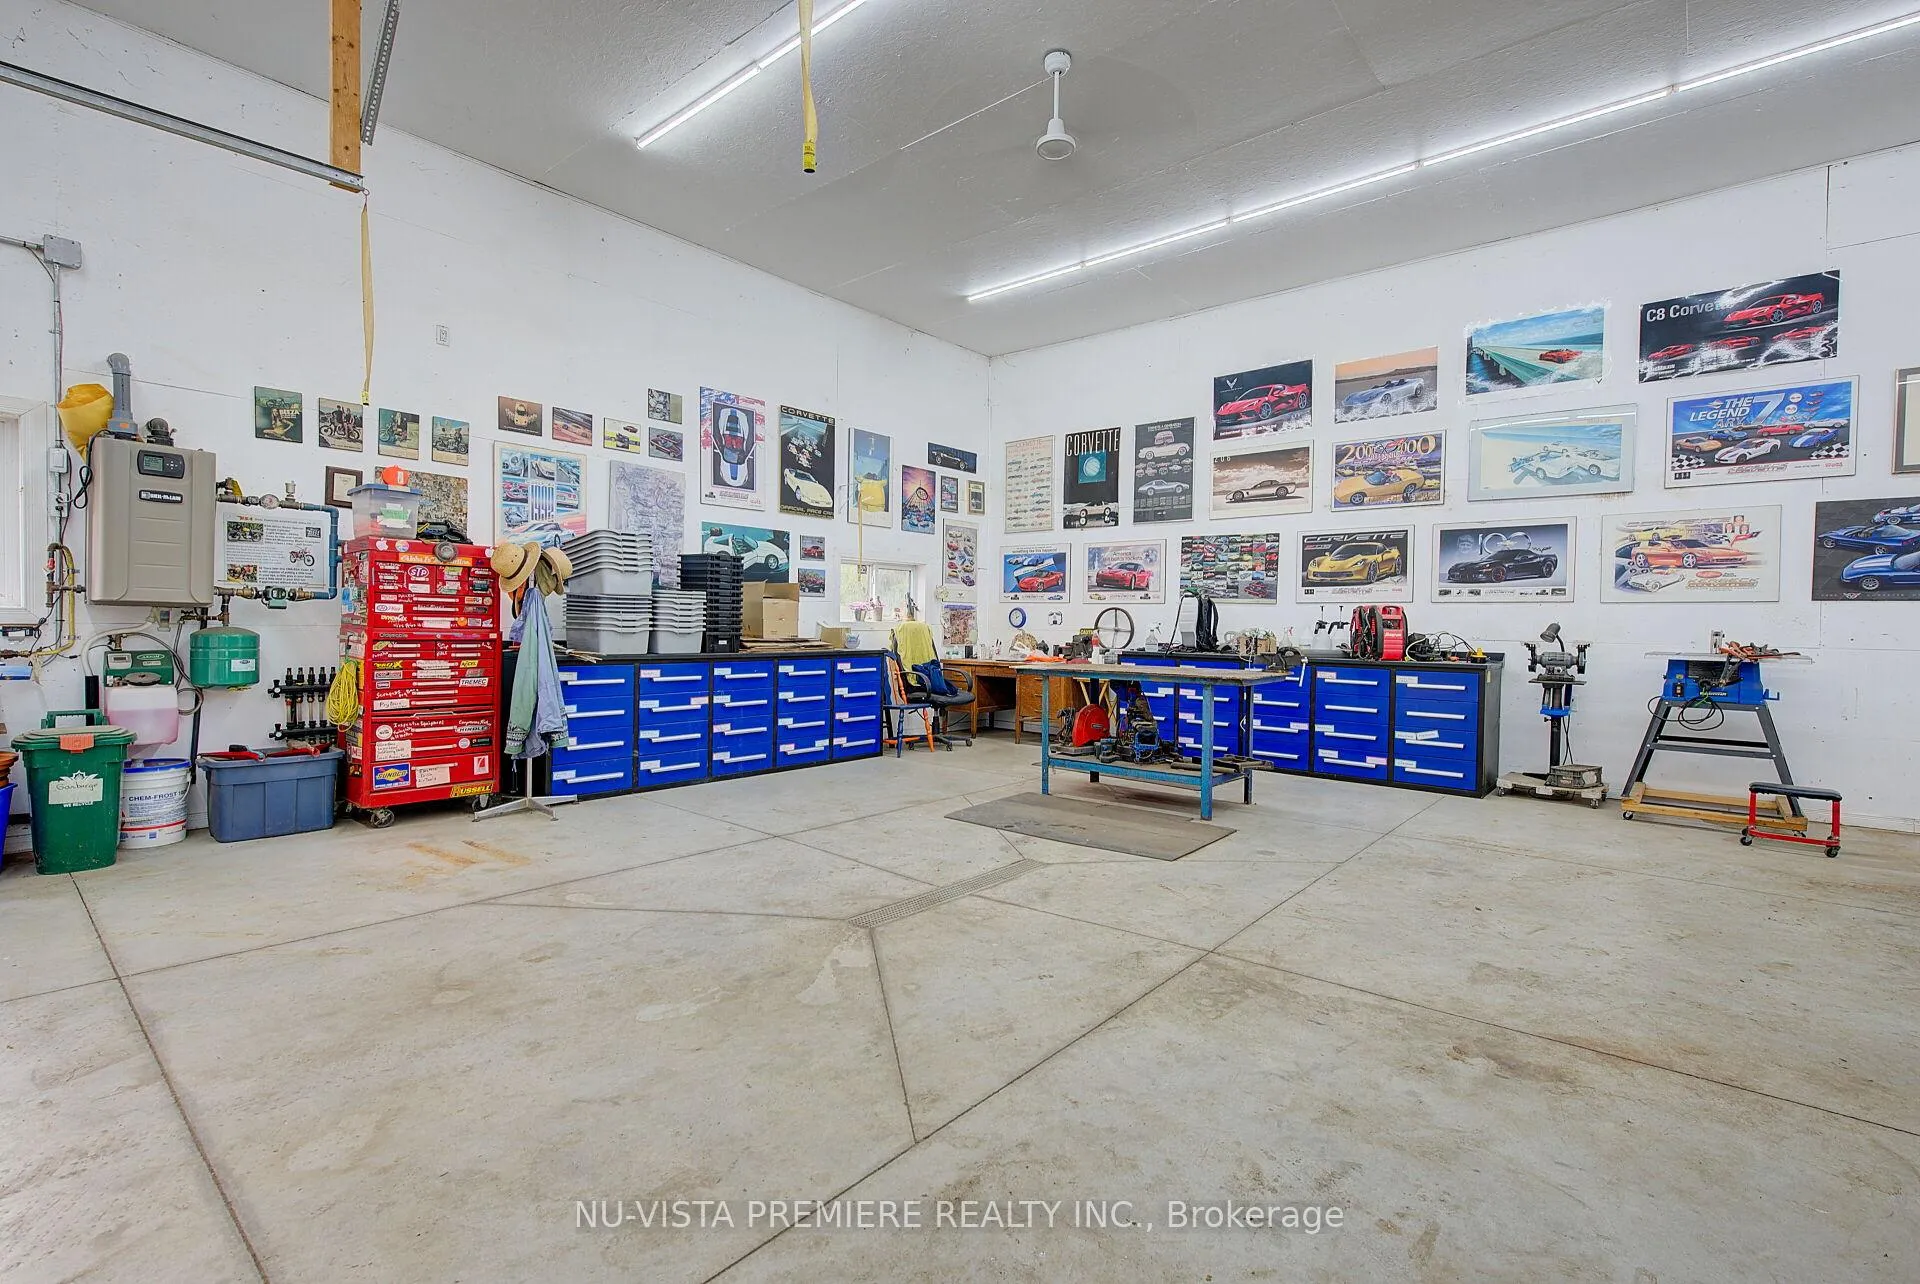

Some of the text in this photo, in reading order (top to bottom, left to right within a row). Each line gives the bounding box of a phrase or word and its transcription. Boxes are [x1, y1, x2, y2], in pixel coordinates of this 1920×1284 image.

[1646, 307, 1666, 322] C8
[1725, 396, 1755, 409] THE
[1750, 392, 1786, 426] 7
[781, 406, 835, 425] CORVETTE
[1689, 406, 1751, 423] LEGEND
[1066, 428, 1120, 457] CORVETTE
[1304, 531, 1407, 543] CORVETTE
[410, 568, 427, 577] STP
[128, 791, 177, 802] CHEM-FROST
